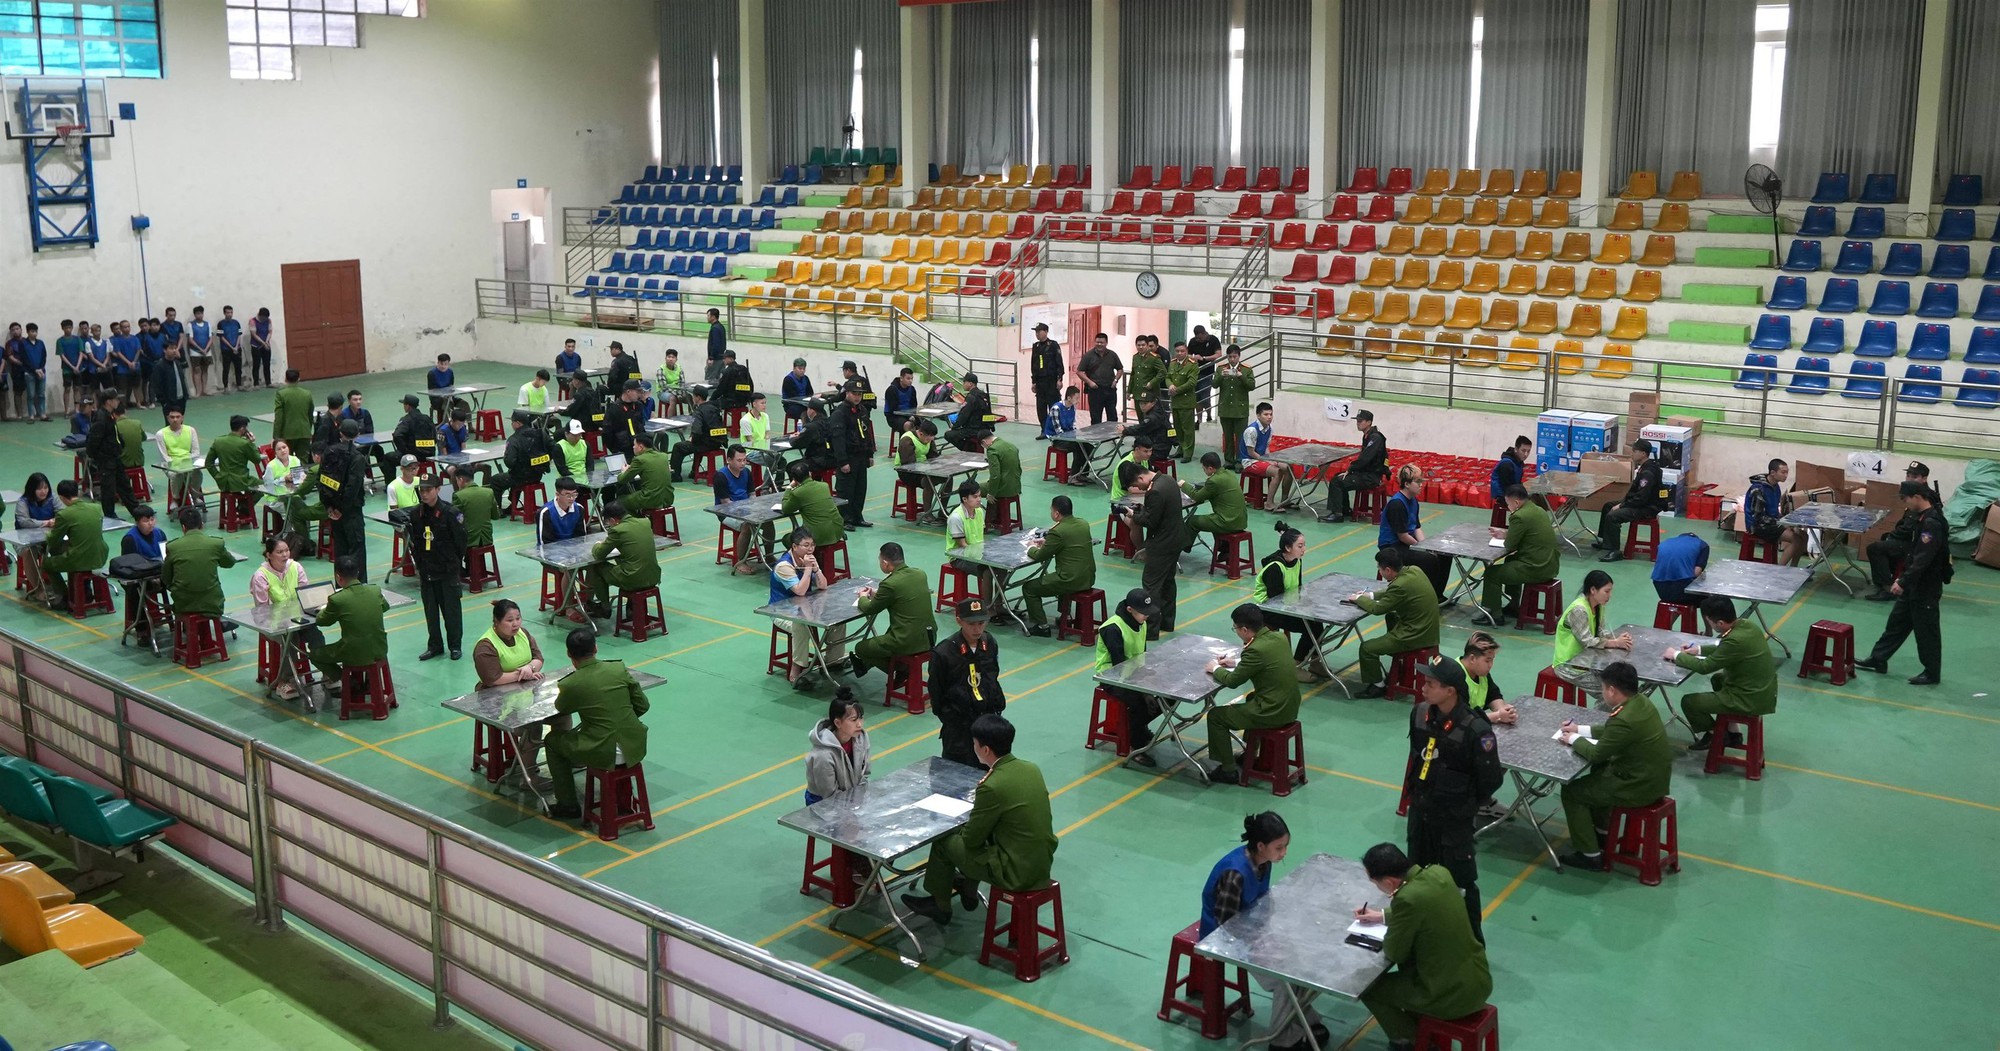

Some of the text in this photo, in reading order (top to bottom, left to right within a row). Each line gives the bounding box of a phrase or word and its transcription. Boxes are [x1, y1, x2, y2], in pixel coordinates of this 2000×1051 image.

[1341, 404, 1349, 417] 3
[1642, 431, 1666, 439] ROSSI
[1872, 459, 1882, 475] 4
